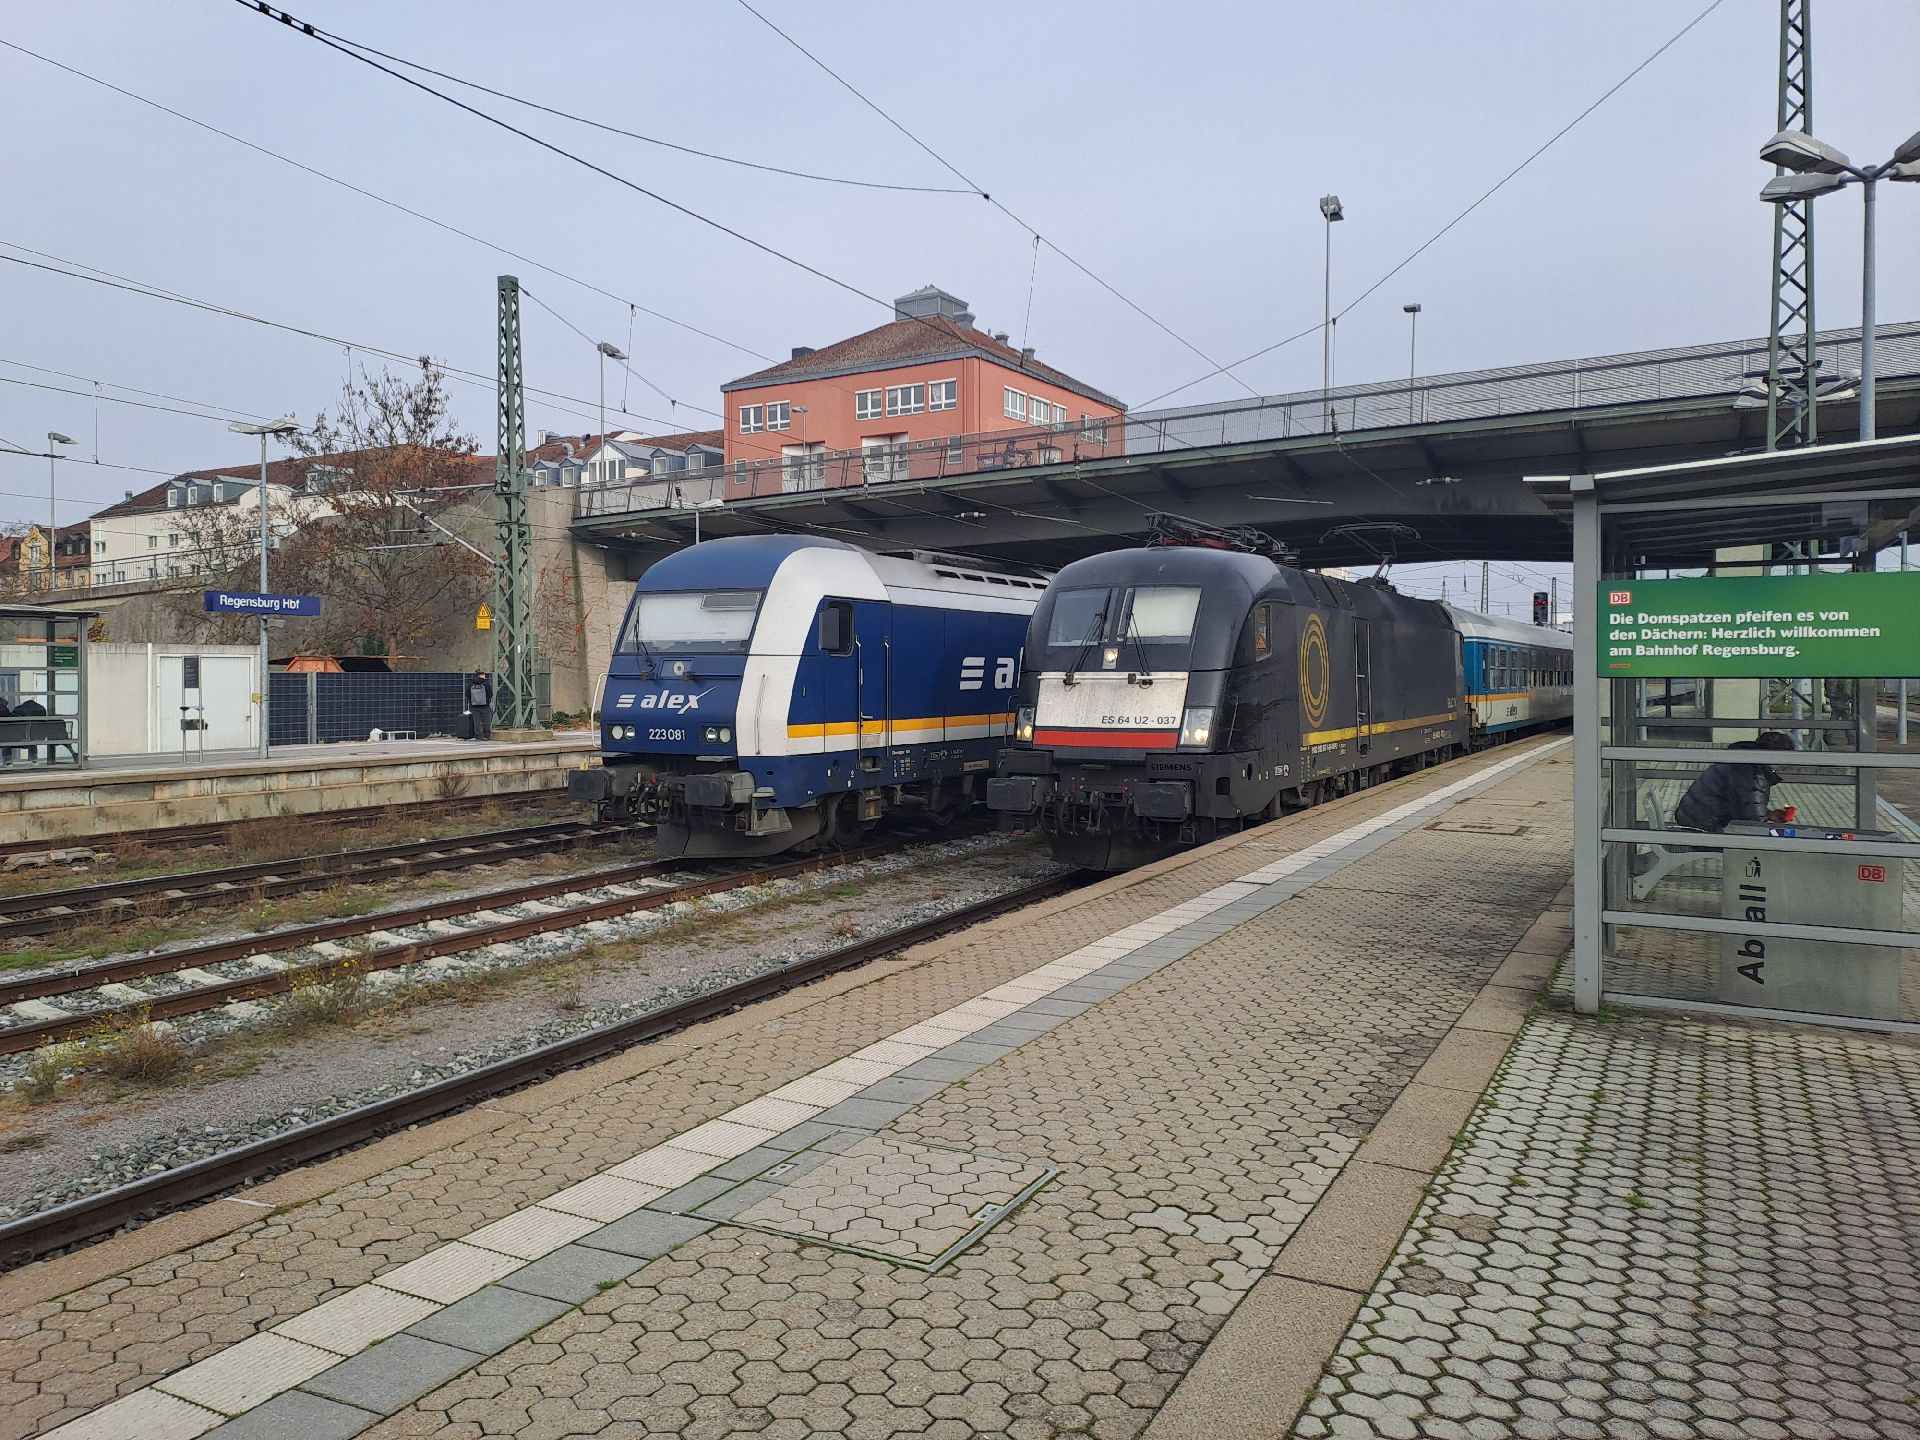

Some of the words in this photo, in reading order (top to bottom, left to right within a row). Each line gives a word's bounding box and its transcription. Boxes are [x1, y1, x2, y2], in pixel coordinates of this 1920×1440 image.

[219, 594, 280, 611] Regensburg
[282, 598, 300, 610] Hbf
[1611, 593, 1629, 604] DB
[1609, 613, 1634, 625] Die
[1637, 612, 1732, 626] Domspatzen
[1735, 610, 1792, 625] pfeifen
[1796, 611, 1815, 622] es
[1819, 611, 1850, 621] von
[1609, 629, 1637, 640] den
[1641, 628, 1708, 640] Dächern:
[1711, 627, 1776, 639] Herzlich
[1780, 626, 1881, 638] willkommen
[1609, 646, 1632, 656] am
[1635, 644, 1699, 656] Bahnhof
[1702, 644, 1801, 658] Regensburg.
[640, 688, 714, 714] alex
[1101, 715, 1115, 725] ES
[1117, 715, 1130, 725] 64
[1134, 716, 1149, 725] U2
[1157, 716, 1176, 725] 037
[1151, 763, 1192, 771] SIEMENS
[1860, 866, 1884, 881] DB
[1737, 884, 1767, 986] Aball
